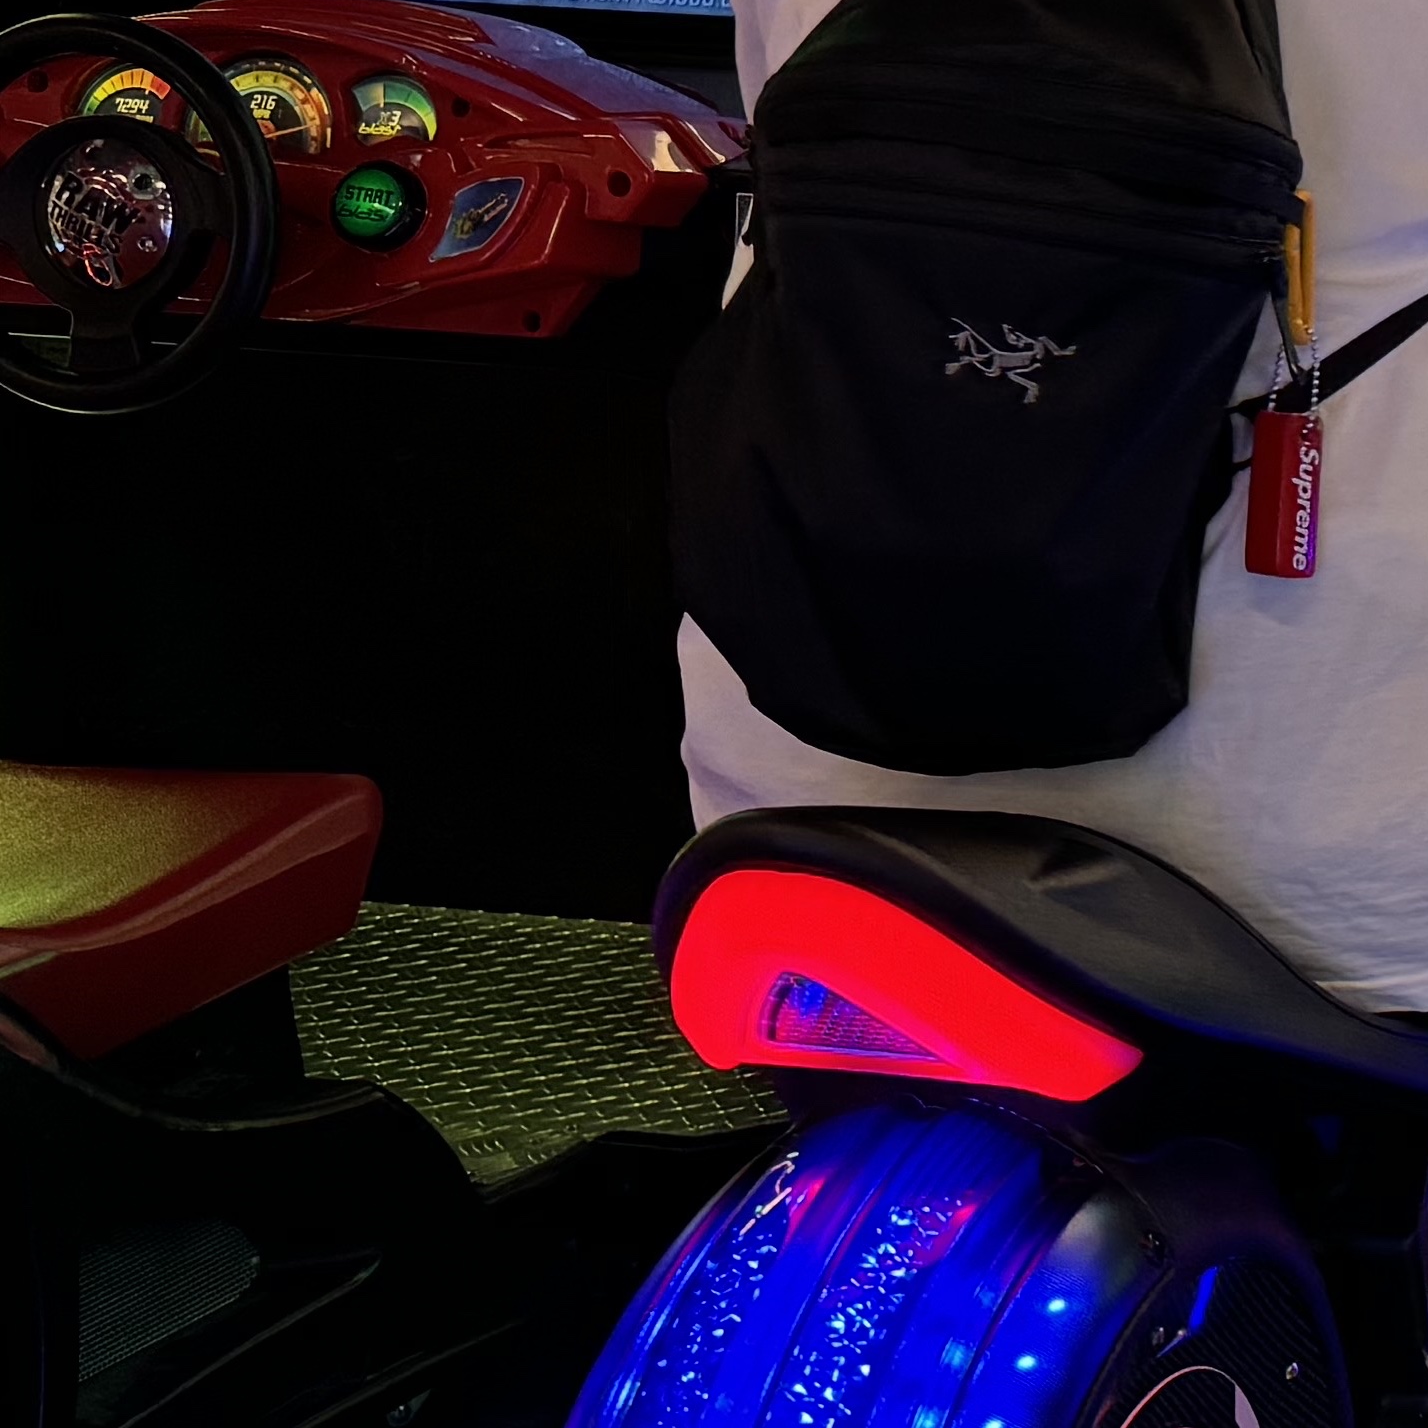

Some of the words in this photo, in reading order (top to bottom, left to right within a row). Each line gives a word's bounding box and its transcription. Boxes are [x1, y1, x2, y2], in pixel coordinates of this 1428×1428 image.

[115, 97, 150, 114] 7294
[250, 93, 277, 110] 216
[55, 172, 141, 235] RAW
[343, 184, 397, 206] START
[337, 203, 393, 223] blas
[1292, 445, 1319, 571] Supreme
